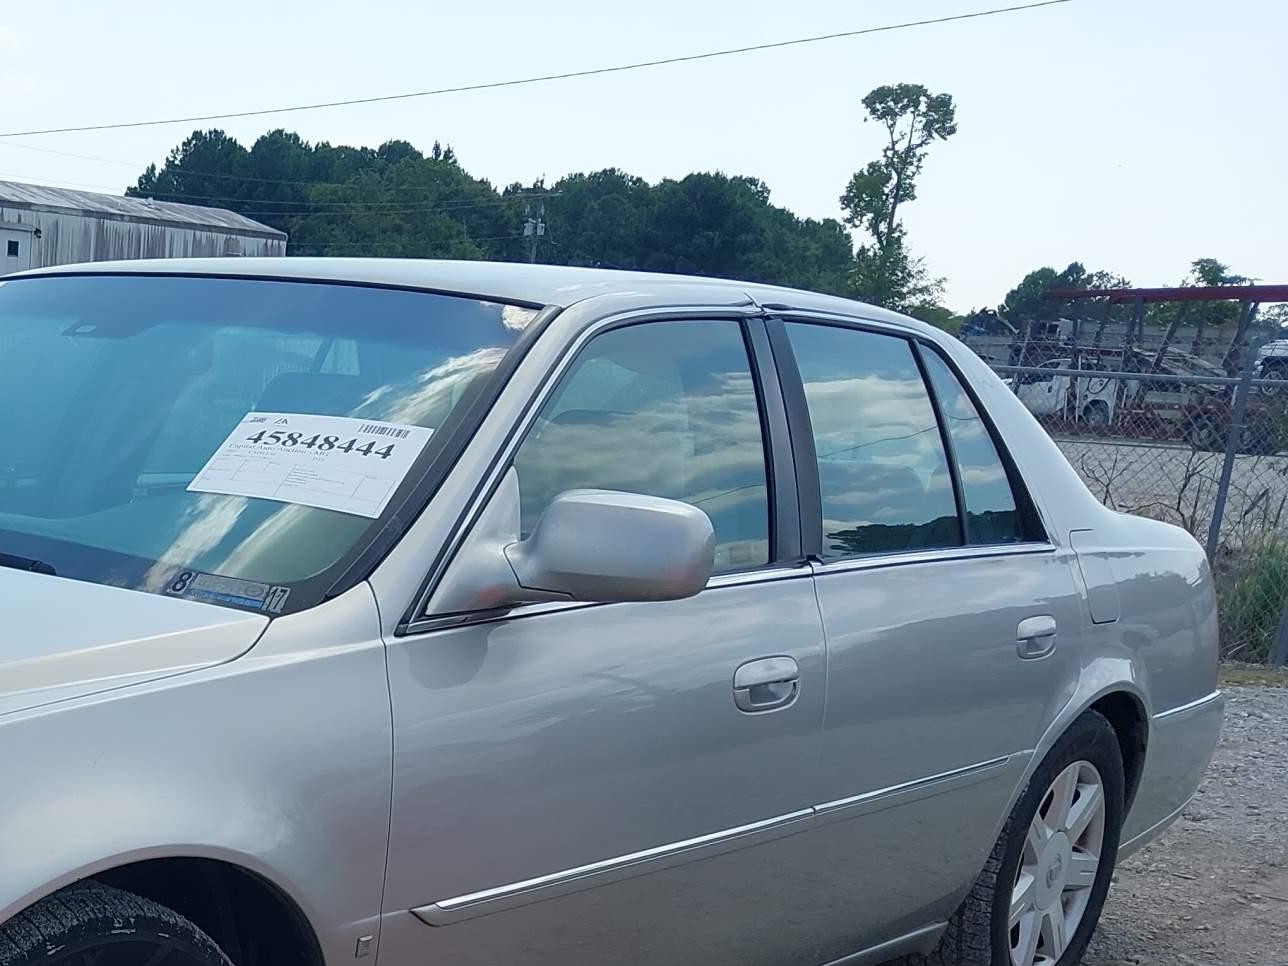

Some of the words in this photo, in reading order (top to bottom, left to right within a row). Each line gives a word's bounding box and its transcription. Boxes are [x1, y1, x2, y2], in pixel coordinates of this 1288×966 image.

[246, 429, 396, 460] 45848444
[172, 571, 192, 592] 8
[267, 587, 288, 610] 17
